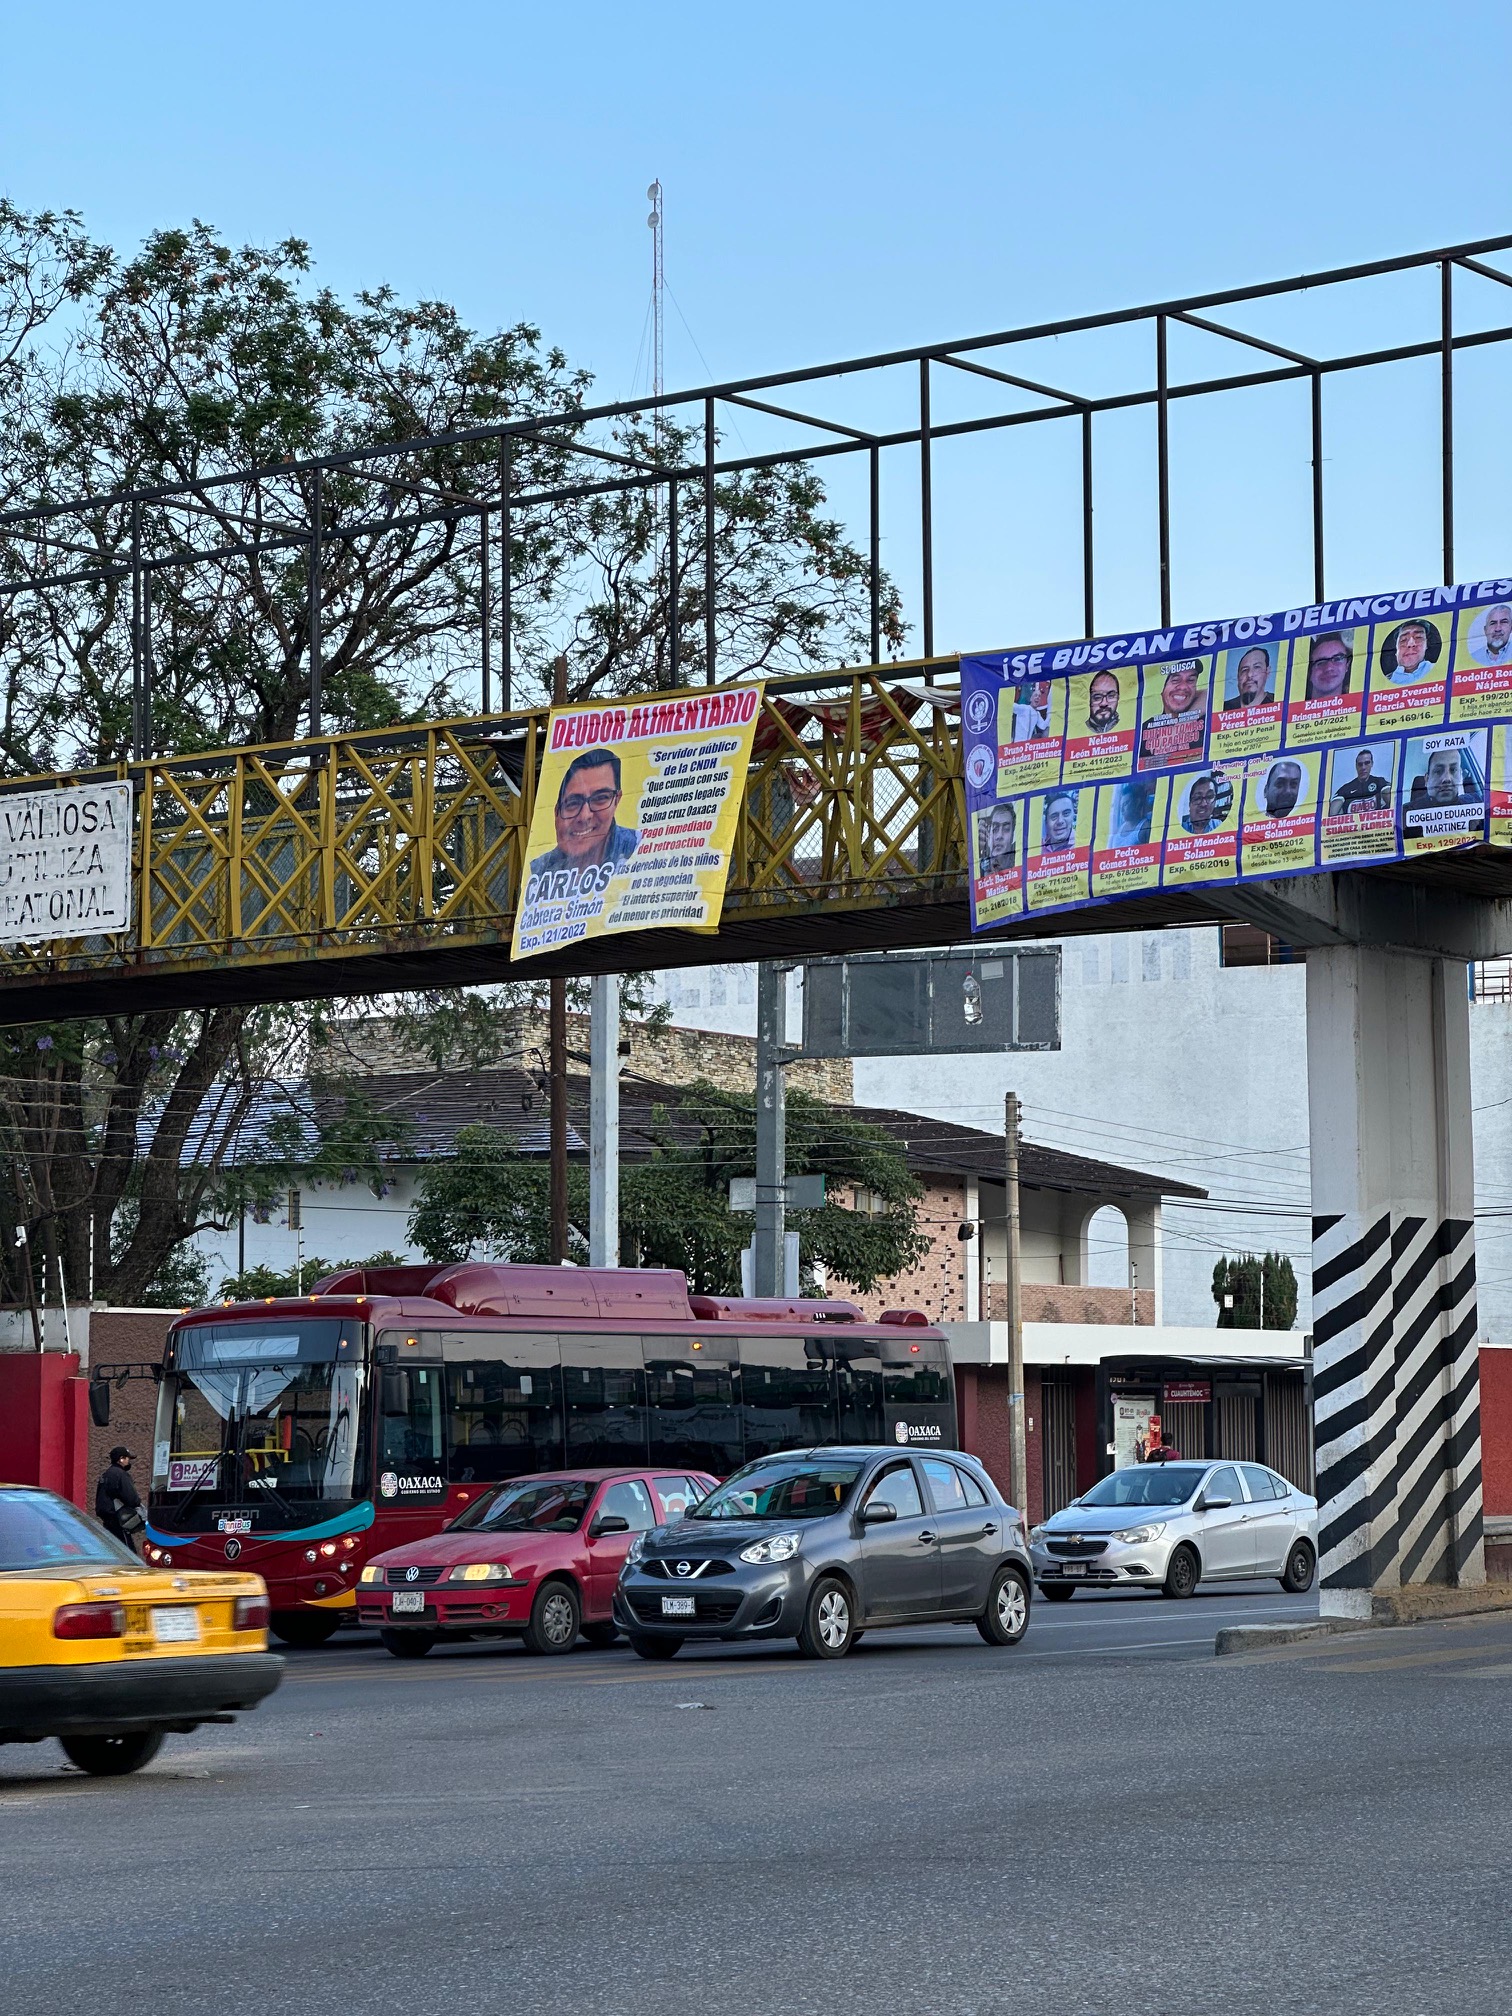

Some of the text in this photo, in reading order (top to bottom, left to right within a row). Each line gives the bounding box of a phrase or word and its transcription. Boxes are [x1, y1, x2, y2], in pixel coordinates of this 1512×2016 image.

[1002, 578, 1512, 681] ¡SE BUSCAN ESTOS DELINCUENTES
[1170, 661, 1196, 674] BUSCA
[1454, 671, 1493, 683] Rodolfo
[1475, 680, 1509, 690] Nájera
[1372, 684, 1444, 702] Diego Everardo
[1246, 702, 1280, 717] Manuel
[1305, 696, 1343, 710] Eduardo
[1374, 696, 1441, 712] García Vargas
[551, 691, 757, 749] DEUDOR ALIMENTARIO
[1220, 715, 1275, 730] Pérez Cortez
[1292, 712, 1321, 722] Bringas
[1314, 716, 1348, 726] 047/2021
[1256, 725, 1274, 733] Penal
[1024, 738, 1060, 752] Fernando
[1088, 734, 1118, 746] Nelson
[1425, 737, 1465, 750] SOY RATA
[699, 740, 738, 758] público
[1032, 749, 1062, 761] Jiménez
[1070, 749, 1090, 760] León
[664, 757, 718, 776] de la CNDH
[1090, 756, 1122, 766] 411/2023
[665, 775, 695, 790] cumpla
[697, 773, 712, 784] con
[713, 770, 728, 782] sus
[640, 786, 726, 809] obligaciones legales
[5, 800, 116, 842] VALIOSA
[642, 803, 716, 824] Salina cruz Oaxaca
[1409, 807, 1483, 824] ROGELIO EDUARDO
[665, 820, 712, 836] inmediato
[1244, 816, 1316, 833] Orlando Mendoza
[1361, 820, 1392, 831] FLORES
[1426, 821, 1466, 834] MARTINEZ
[1264, 828, 1294, 839] Solano
[637, 836, 706, 856] del retroactivo
[1166, 834, 1235, 852] Dahir Mendoza
[1270, 838, 1304, 850] 055/2012
[1040, 851, 1076, 866] Armando
[1114, 847, 1140, 858] Pedro
[1184, 848, 1215, 860] Solano
[631, 857, 666, 874] derechos
[668, 856, 678, 867] de
[680, 854, 693, 866] los
[694, 852, 720, 866] niños
[1099, 854, 1154, 871] Gómez Rosas
[1169, 858, 1230, 874] Exp. 656/2019
[1027, 861, 1088, 880] Rodríguez Reyes
[1100, 872, 1114, 880] Exp.
[524, 865, 613, 906] CARLOS
[631, 879, 642, 890] no
[642, 878, 653, 888] se
[520, 896, 604, 930] Cabrera Simón
[608, 906, 704, 924] del menor es prioridad
[908, 1426, 941, 1436] OAXACA
[398, 1476, 442, 1489] OAXACA
